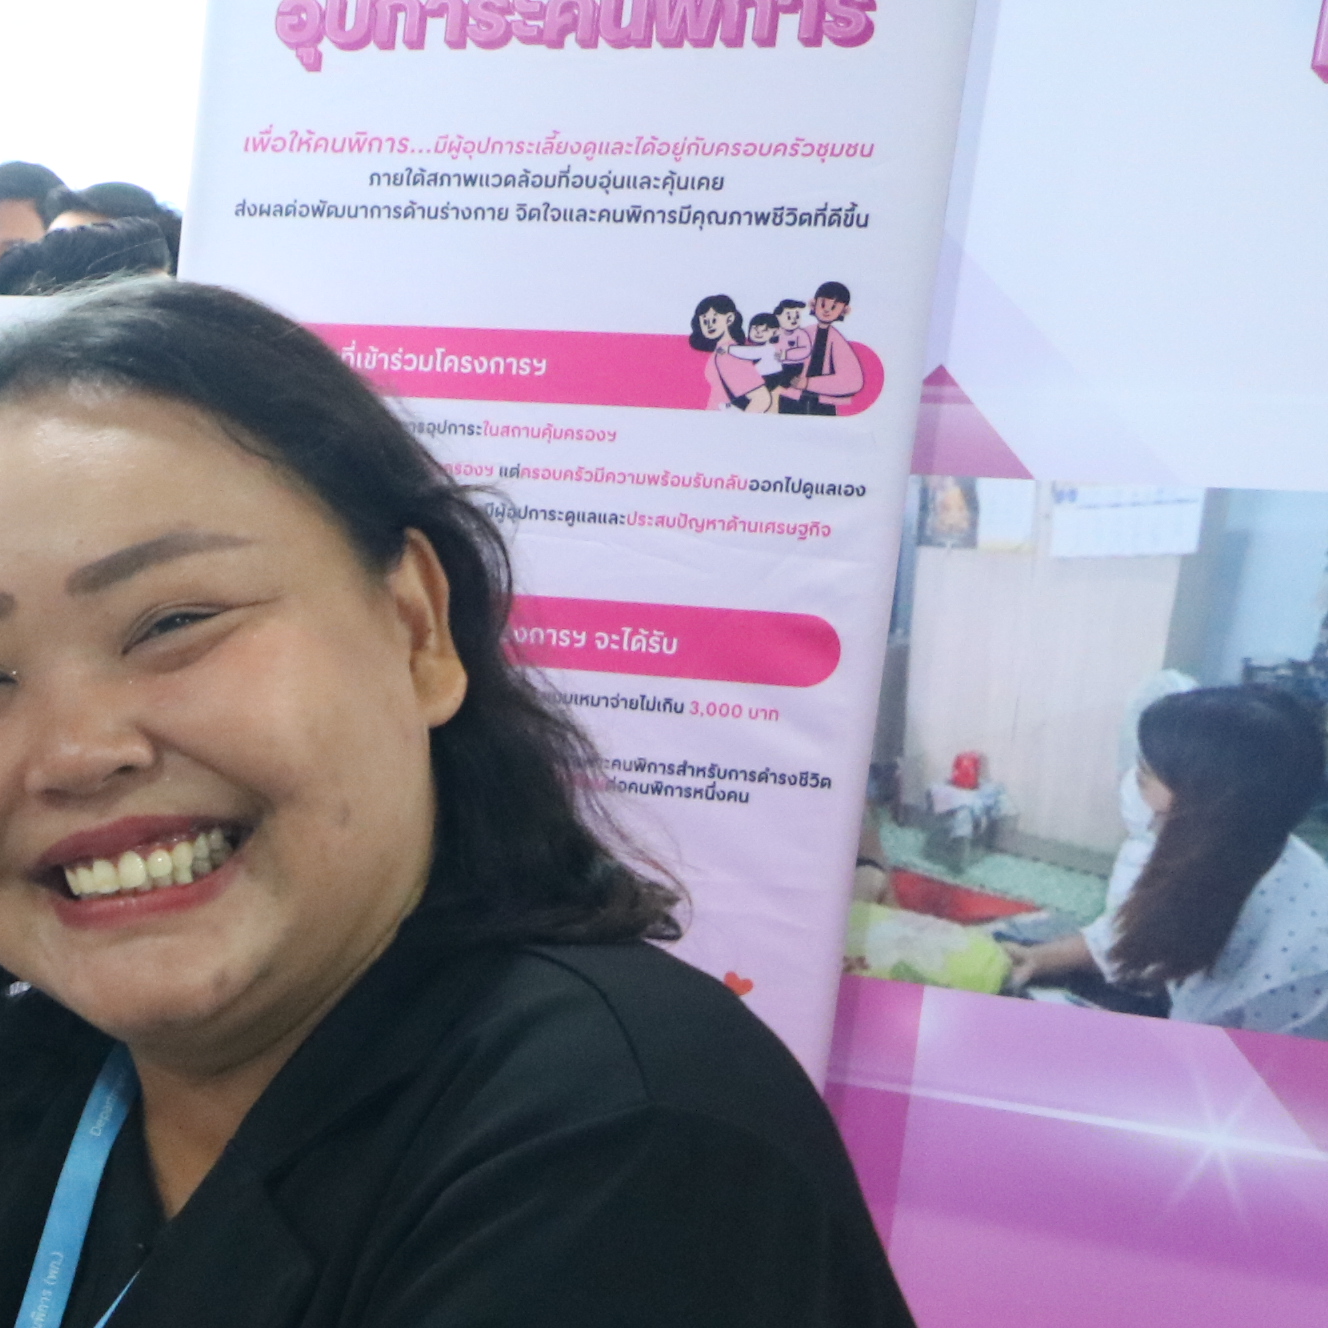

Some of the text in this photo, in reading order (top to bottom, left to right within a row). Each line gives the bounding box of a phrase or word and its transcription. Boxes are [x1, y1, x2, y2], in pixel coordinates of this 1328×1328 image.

[274, 0, 877, 72] อุปการะคนพการ
[369, 166, 724, 195] ภายใต้สภาพแวดล้อมที่อบอุ่นและคุ้นเคย
[234, 198, 869, 230] ส่งผลต่อพัฒนาการด้านร่างกาย จิตใจและคนพิการมีคุณภาพชีวิตที่ดีขึ้น
[341, 340, 547, 376] ที่เข้าร่วมโครงการฯ
[408, 419, 616, 444] ารอุปการะในสถานคุ้มครองฯ
[485, 502, 832, 541] มีผู้อุปการะดูแลและประสบปัญหาด้านเศรษฐกิจ
[513, 626, 678, 655] งการฯ จะได้รับ
[689, 700, 742, 719] 3,000
[748, 706, 779, 722] บาท
[604, 757, 832, 790] ะคนพิการสำหรับการดำรงชีวิต
